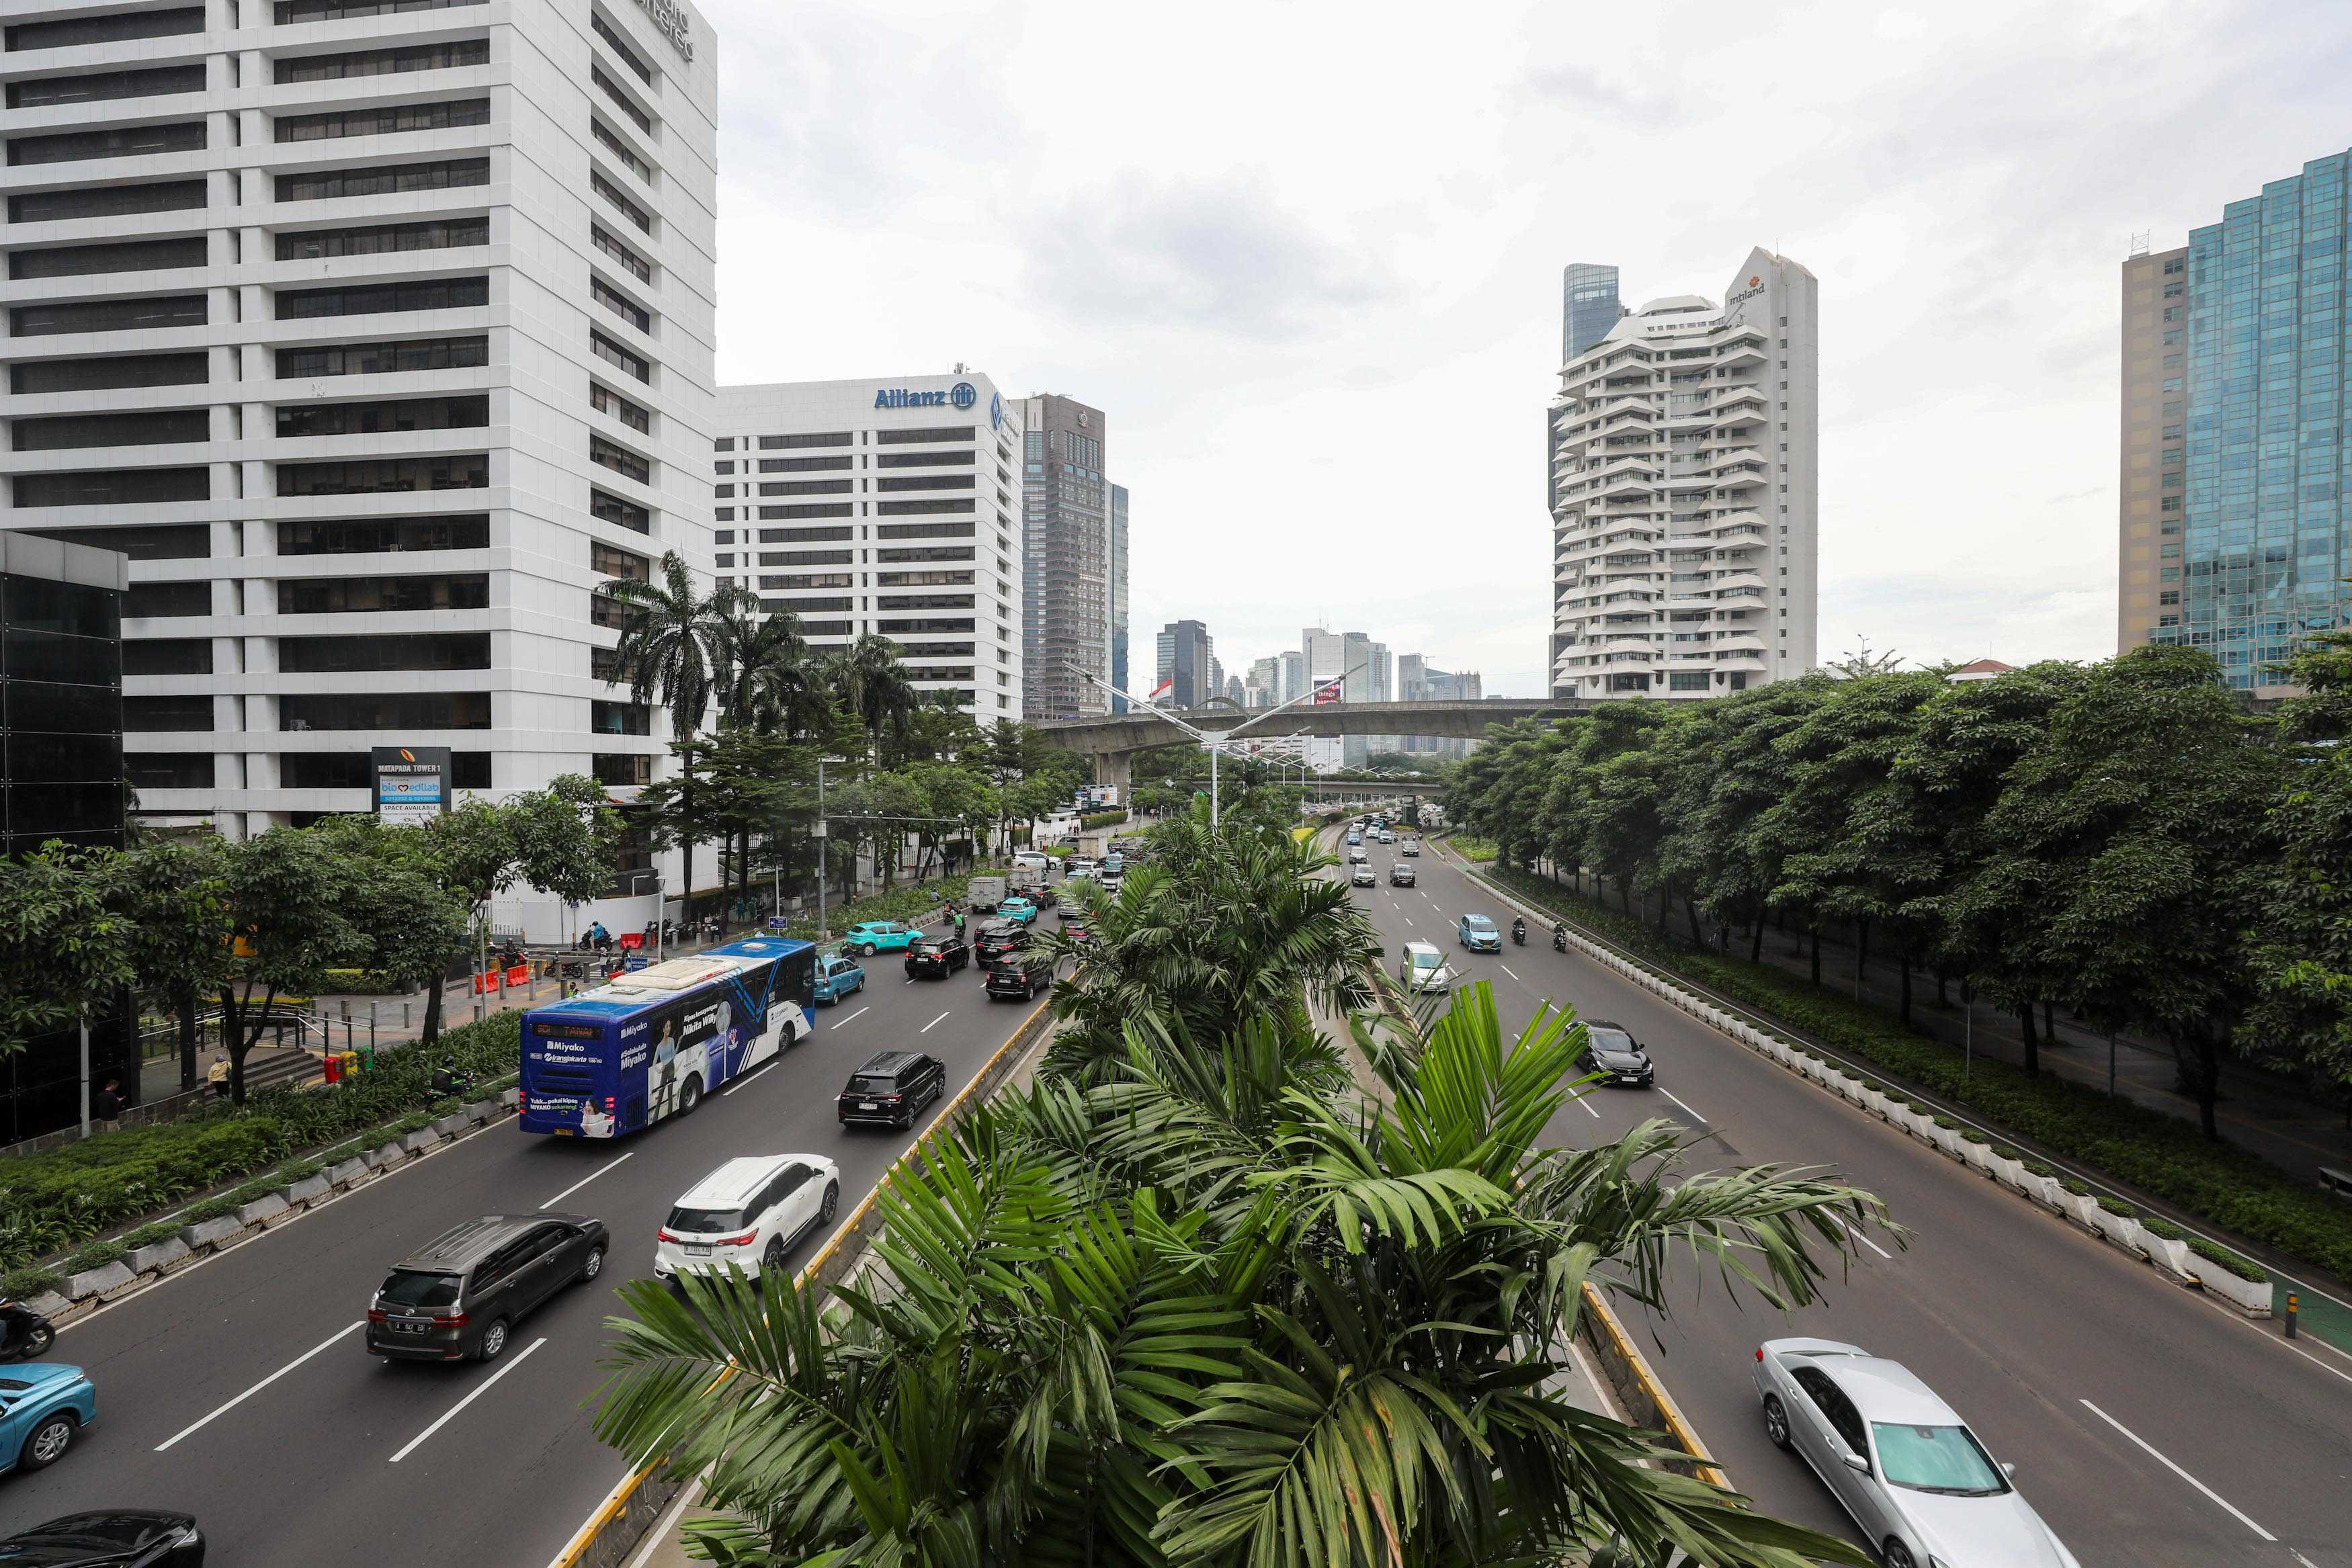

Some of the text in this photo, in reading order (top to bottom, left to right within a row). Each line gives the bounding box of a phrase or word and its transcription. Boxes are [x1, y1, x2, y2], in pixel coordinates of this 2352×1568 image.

[1730, 283, 1765, 305] intiland
[874, 388, 945, 408] Allianz
[684, 1004, 718, 1022] Kipas kesayangan
[626, 1022, 647, 1037] Miyako
[683, 1012, 717, 1036] Nikita Willy
[554, 1042, 585, 1052] Miyako
[552, 1054, 587, 1063] transjakarta
[621, 1052, 646, 1070] Miyako
